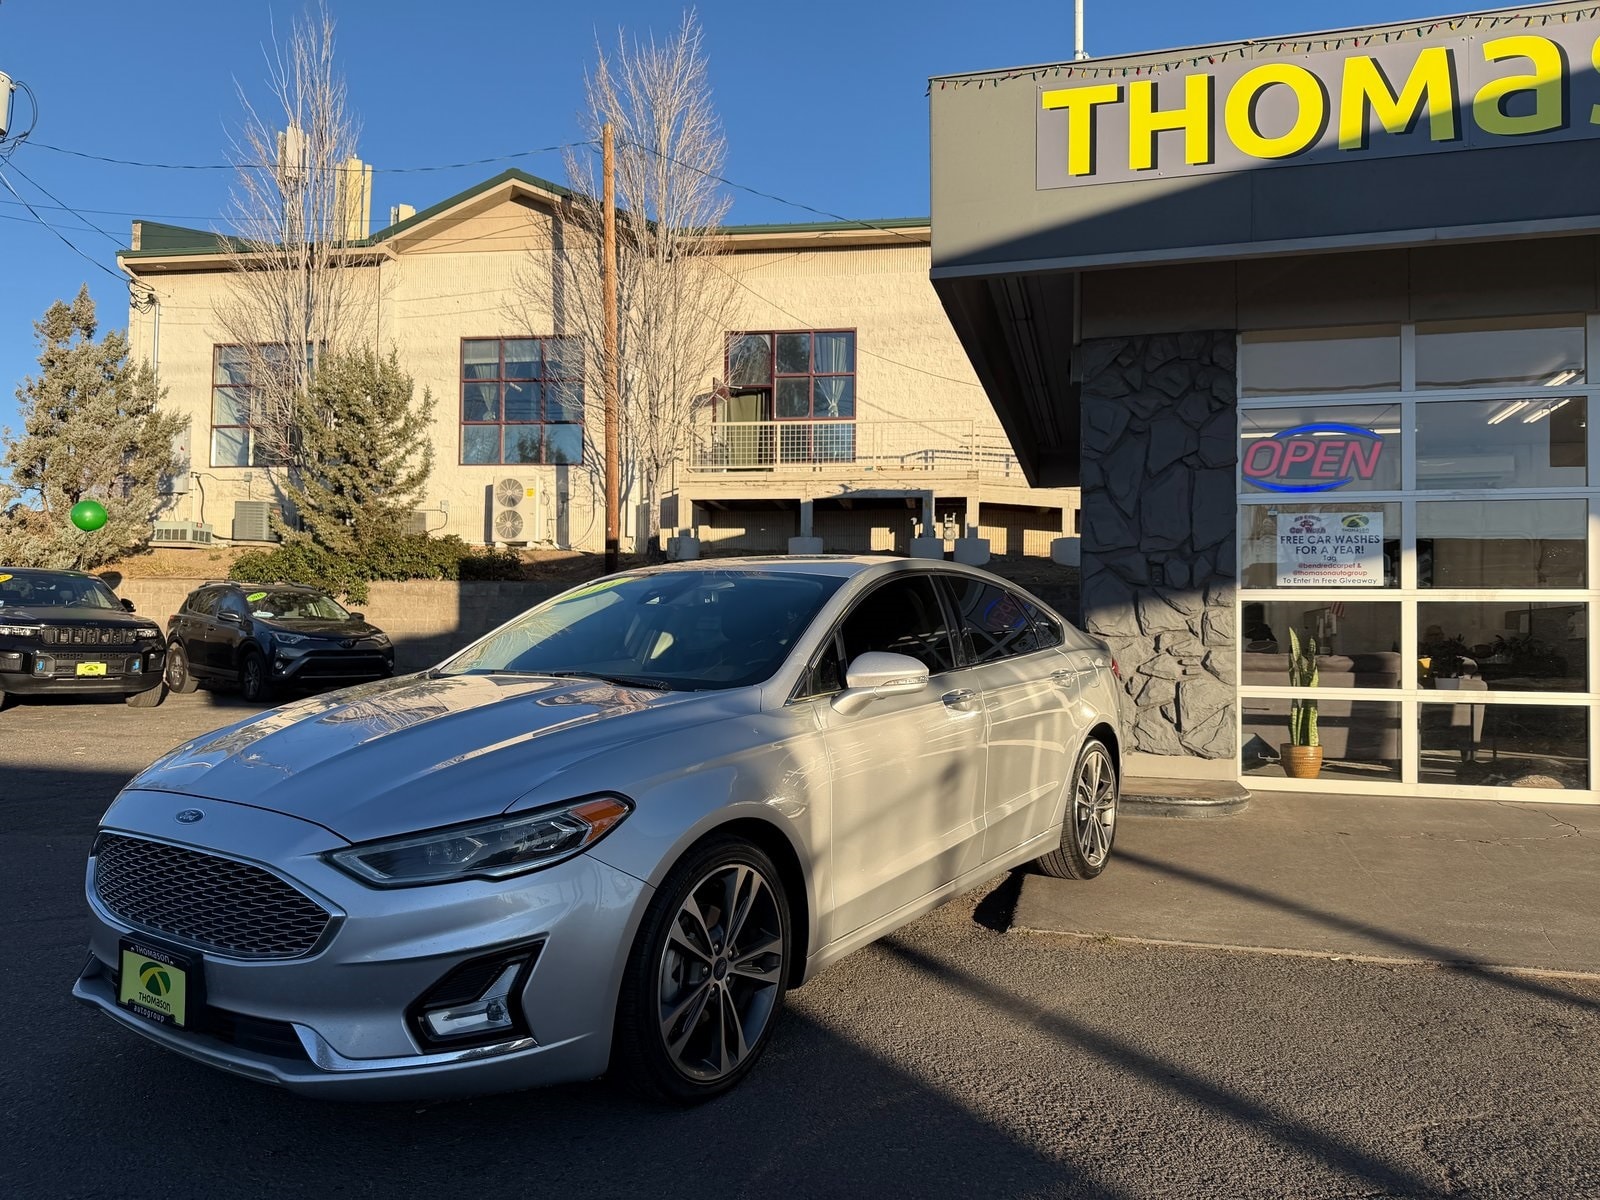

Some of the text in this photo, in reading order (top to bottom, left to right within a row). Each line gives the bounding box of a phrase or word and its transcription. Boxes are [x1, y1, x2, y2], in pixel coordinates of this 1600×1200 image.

[1042, 35, 1600, 176] THOMa
[1243, 440, 1383, 478] OPEN
[1305, 526, 1326, 534] Wash
[1280, 534, 1380, 544] FREE CAR WASHES
[1295, 545, 1365, 555] FOR A YEAR!
[1298, 562, 1356, 570] @bendredcarpet
[1339, 577, 1378, 585] Giveaway
[133, 1004, 165, 1023] autogroup
